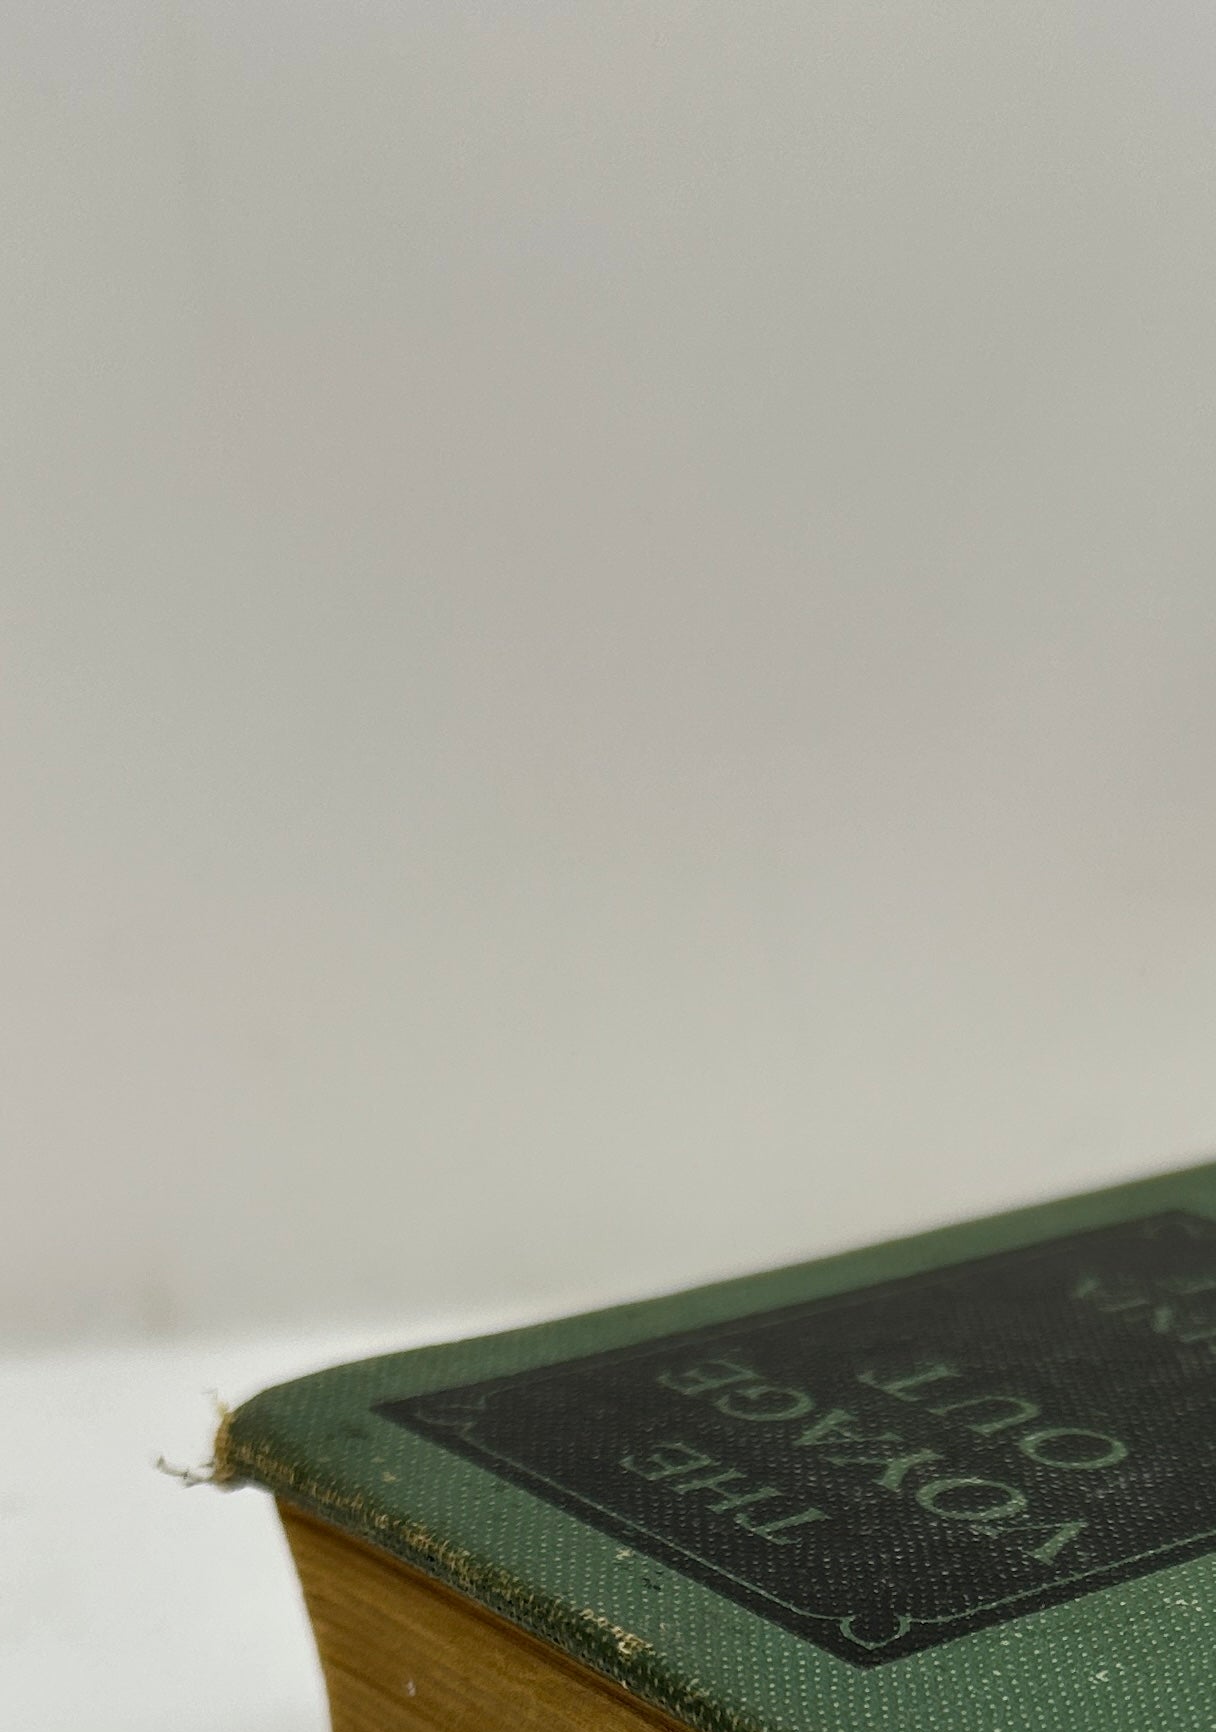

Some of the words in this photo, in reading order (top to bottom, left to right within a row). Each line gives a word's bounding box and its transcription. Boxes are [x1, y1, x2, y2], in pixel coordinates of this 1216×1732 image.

[656, 1358, 1090, 1567] VOYAGE
[856, 1361, 1129, 1470] OUT
[619, 1442, 833, 1546] THE
